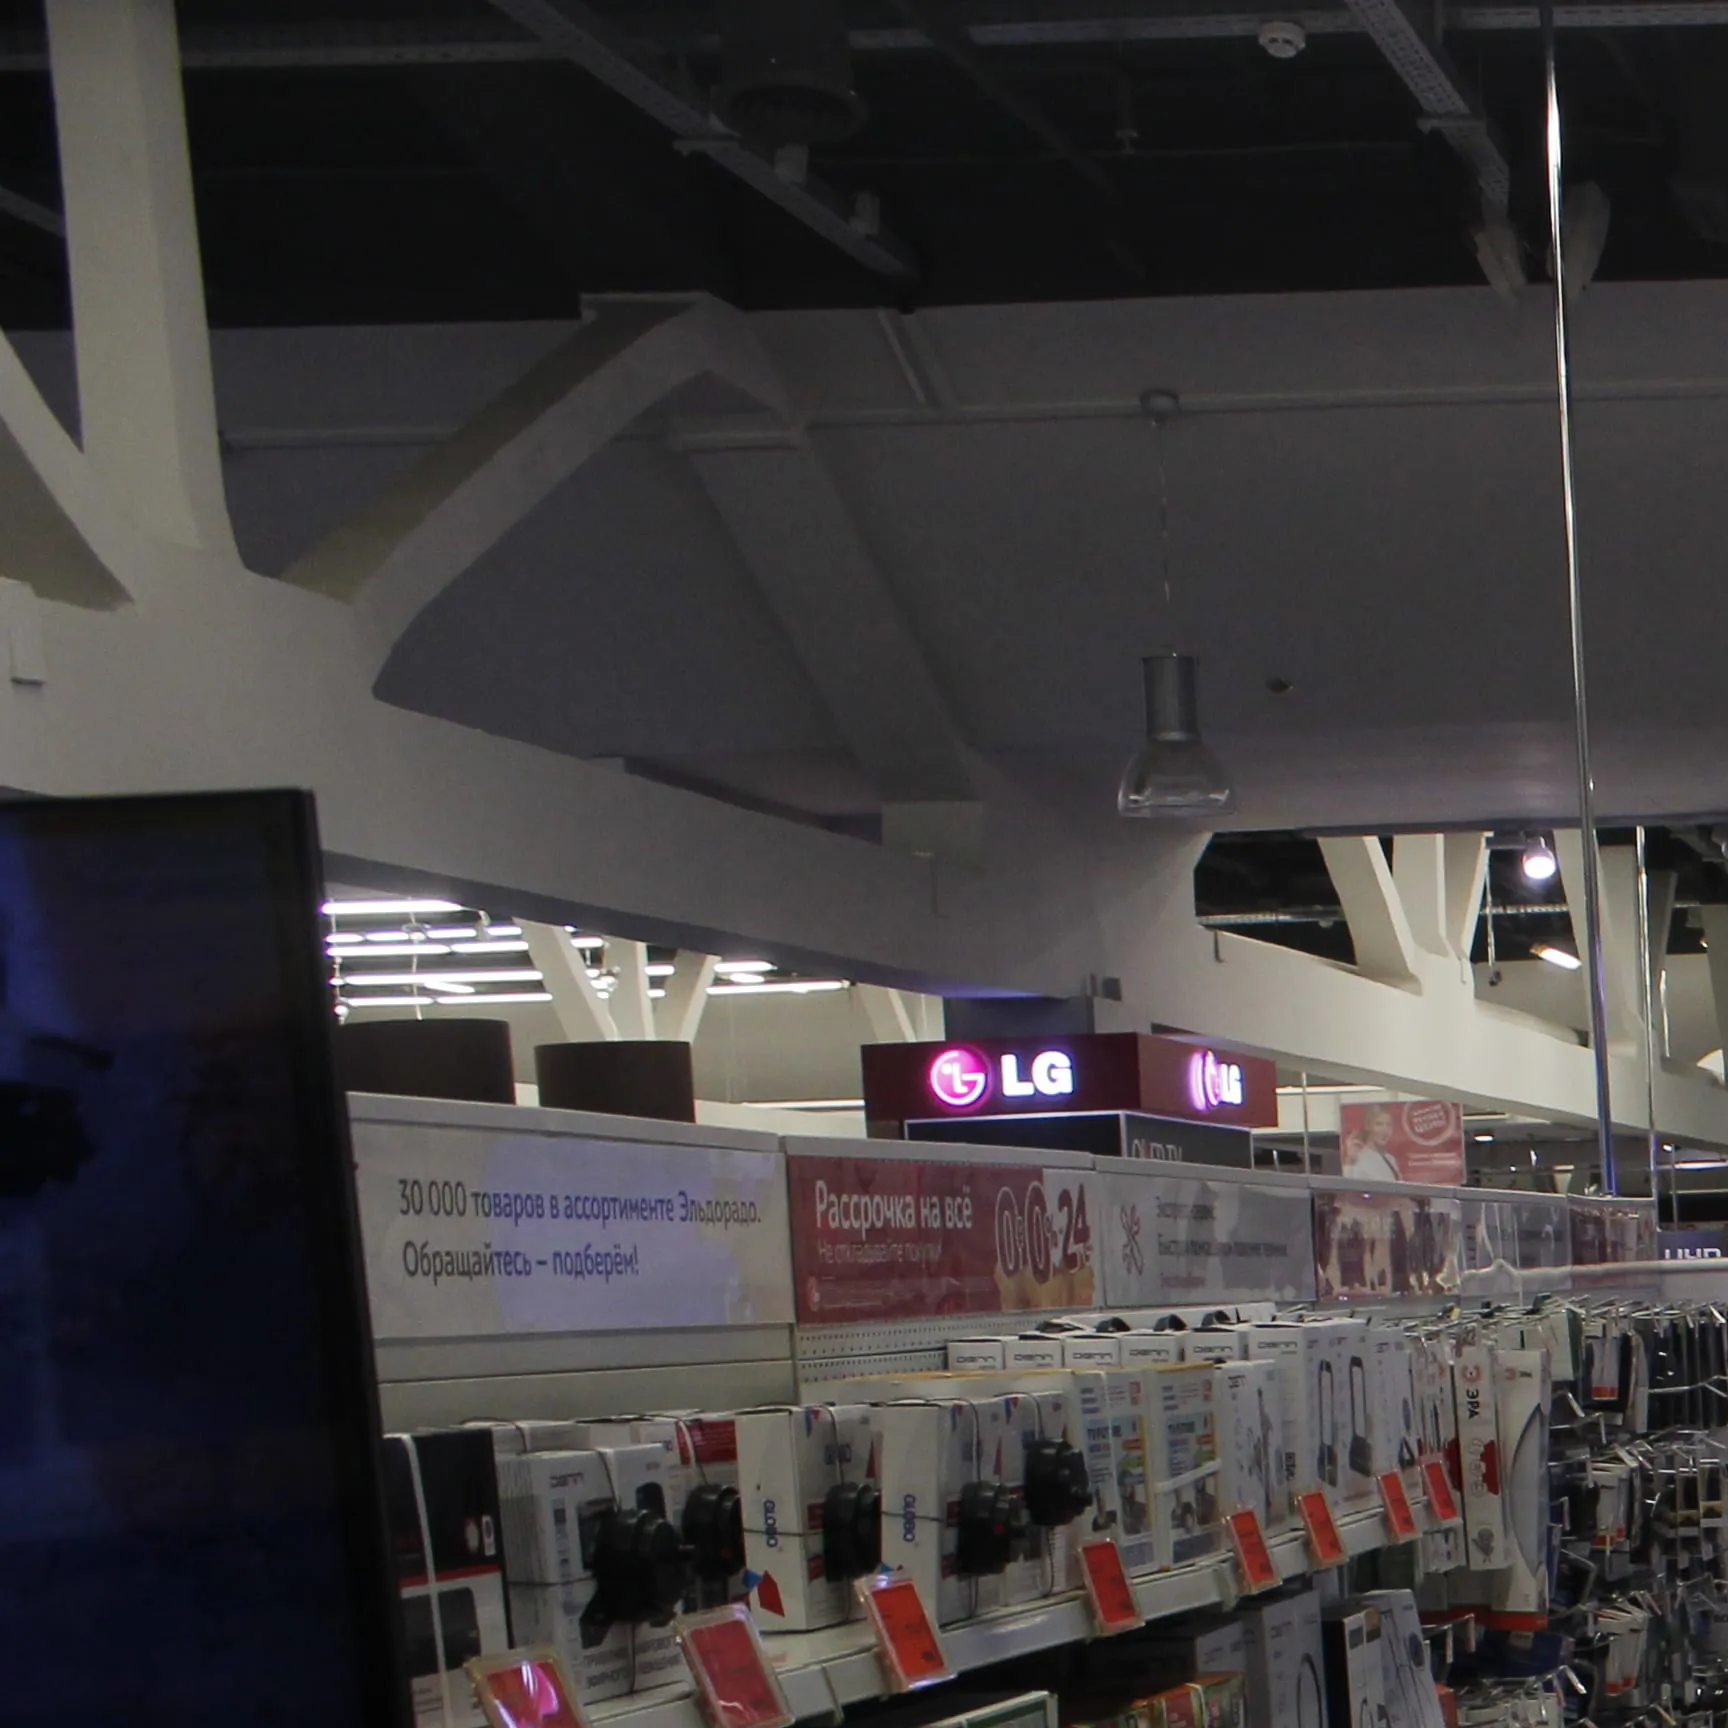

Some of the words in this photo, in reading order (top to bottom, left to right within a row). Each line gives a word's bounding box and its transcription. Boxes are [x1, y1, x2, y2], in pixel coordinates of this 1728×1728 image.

[1001, 1050, 1077, 1097] LG
[398, 1179, 423, 1217] 30
[429, 1180, 467, 1218] 000
[470, 1190, 546, 1226] товаров
[549, 1194, 560, 1220] в
[563, 1194, 675, 1229] ассортименте
[678, 1190, 763, 1228] Эльдорадо.
[814, 1180, 917, 1240] Рассрочка
[920, 1192, 942, 1229] на
[945, 1184, 974, 1229] всё
[402, 1240, 533, 1287] Обращайтесь
[551, 1243, 641, 1284] подберём!
[1467, 1388, 1480, 1420] ЭРА
[763, 1500, 778, 1548] GLOBO
[903, 1493, 917, 1543] GLOBO
